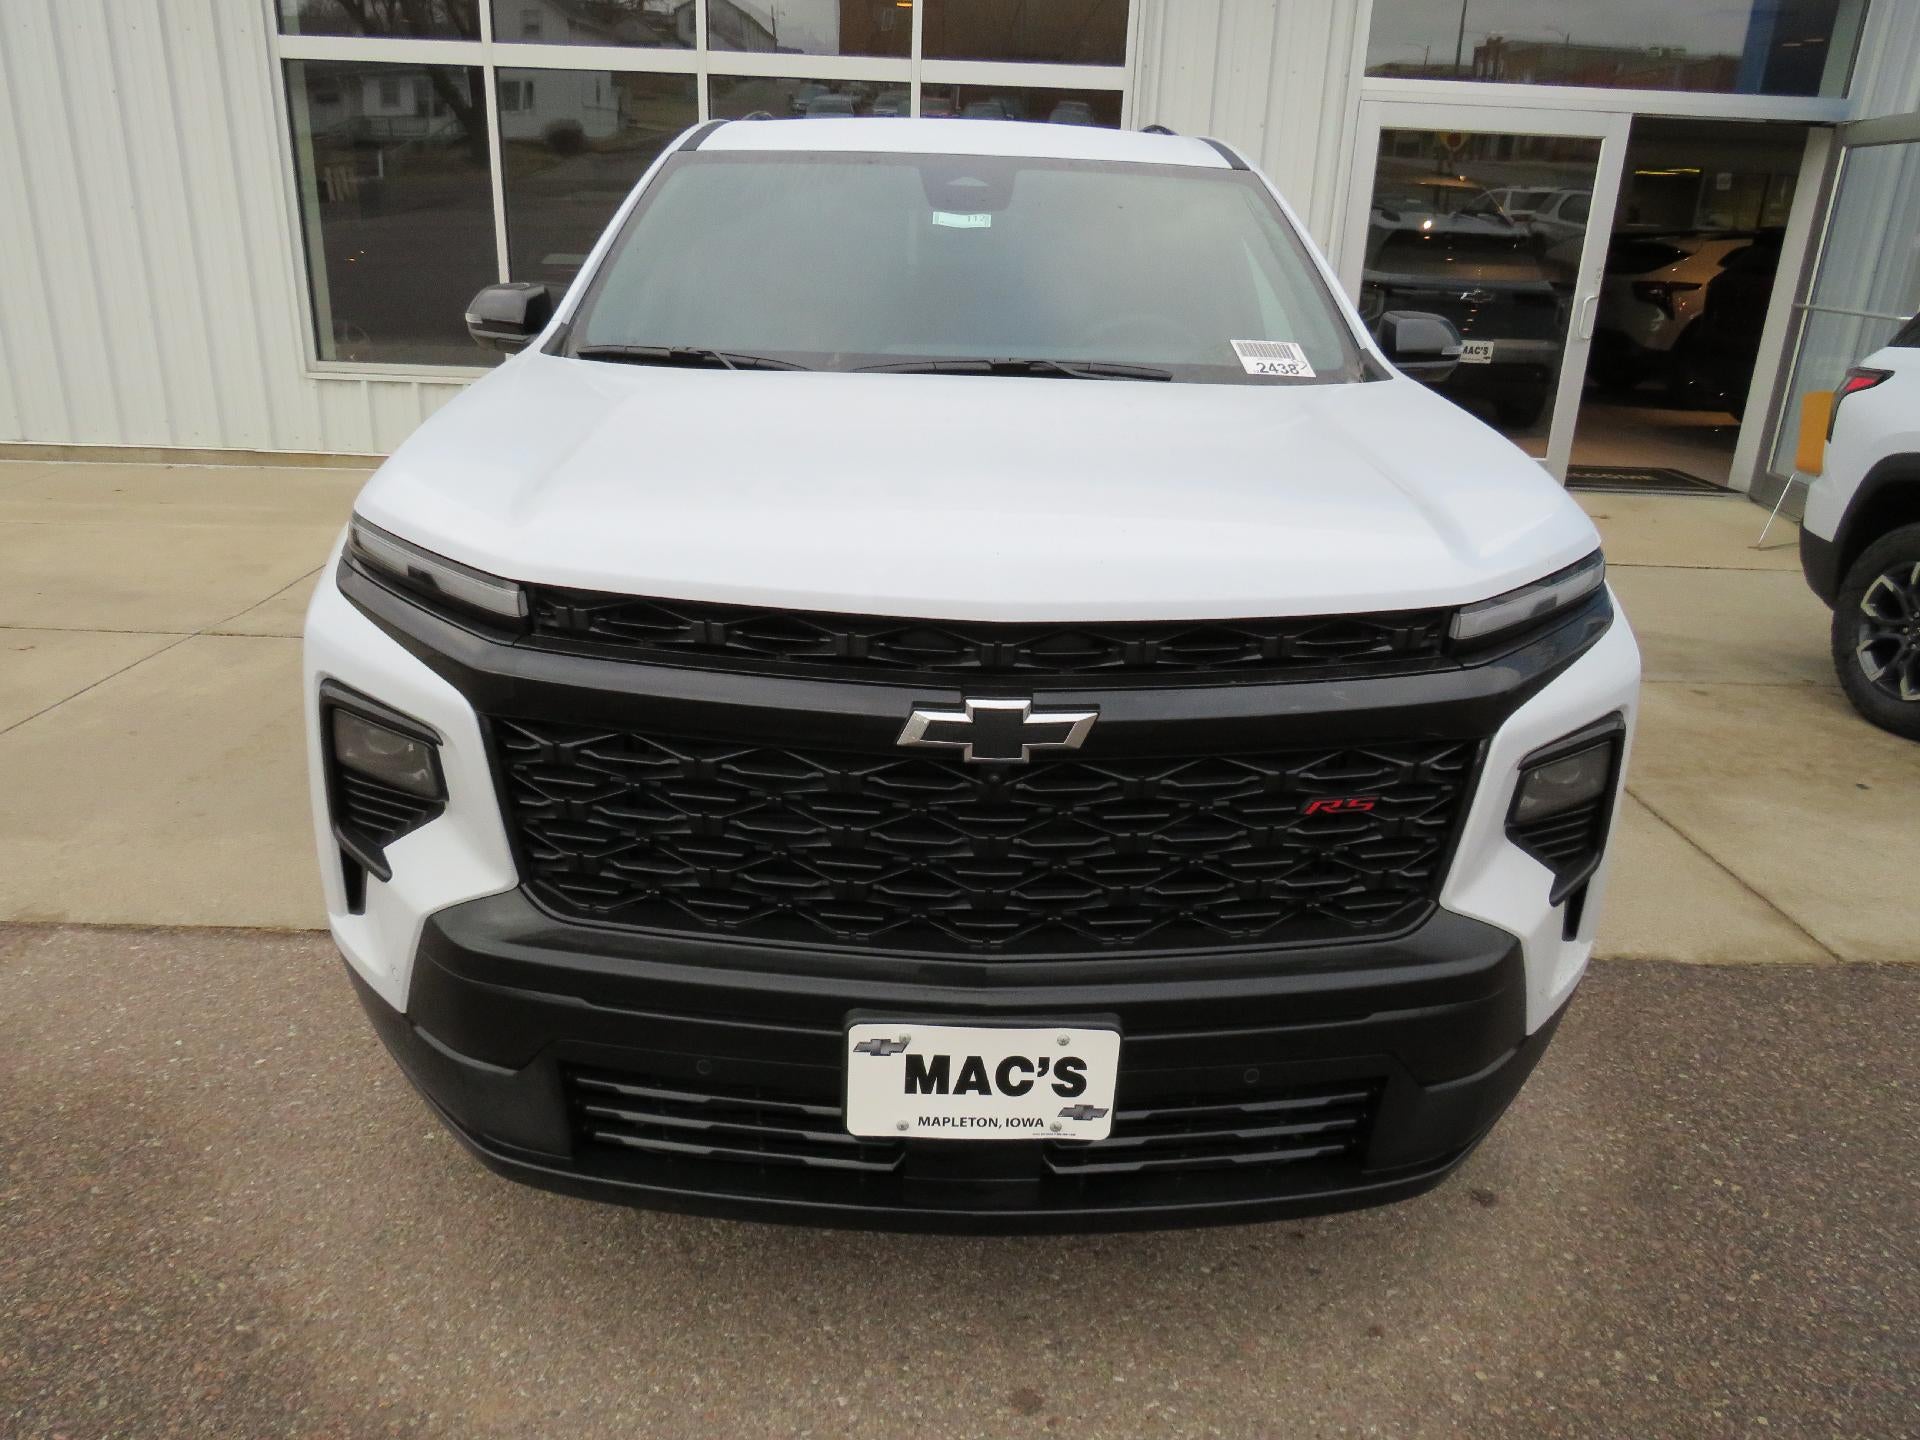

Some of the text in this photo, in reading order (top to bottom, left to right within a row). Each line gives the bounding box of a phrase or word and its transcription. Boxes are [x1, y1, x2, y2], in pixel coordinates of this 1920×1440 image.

[1256, 362, 1300, 375] 2438
[1303, 798, 1375, 816] RS
[904, 1054, 1088, 1098] MAC'S
[917, 1115, 1044, 1130] MAPLETON, IOWA
